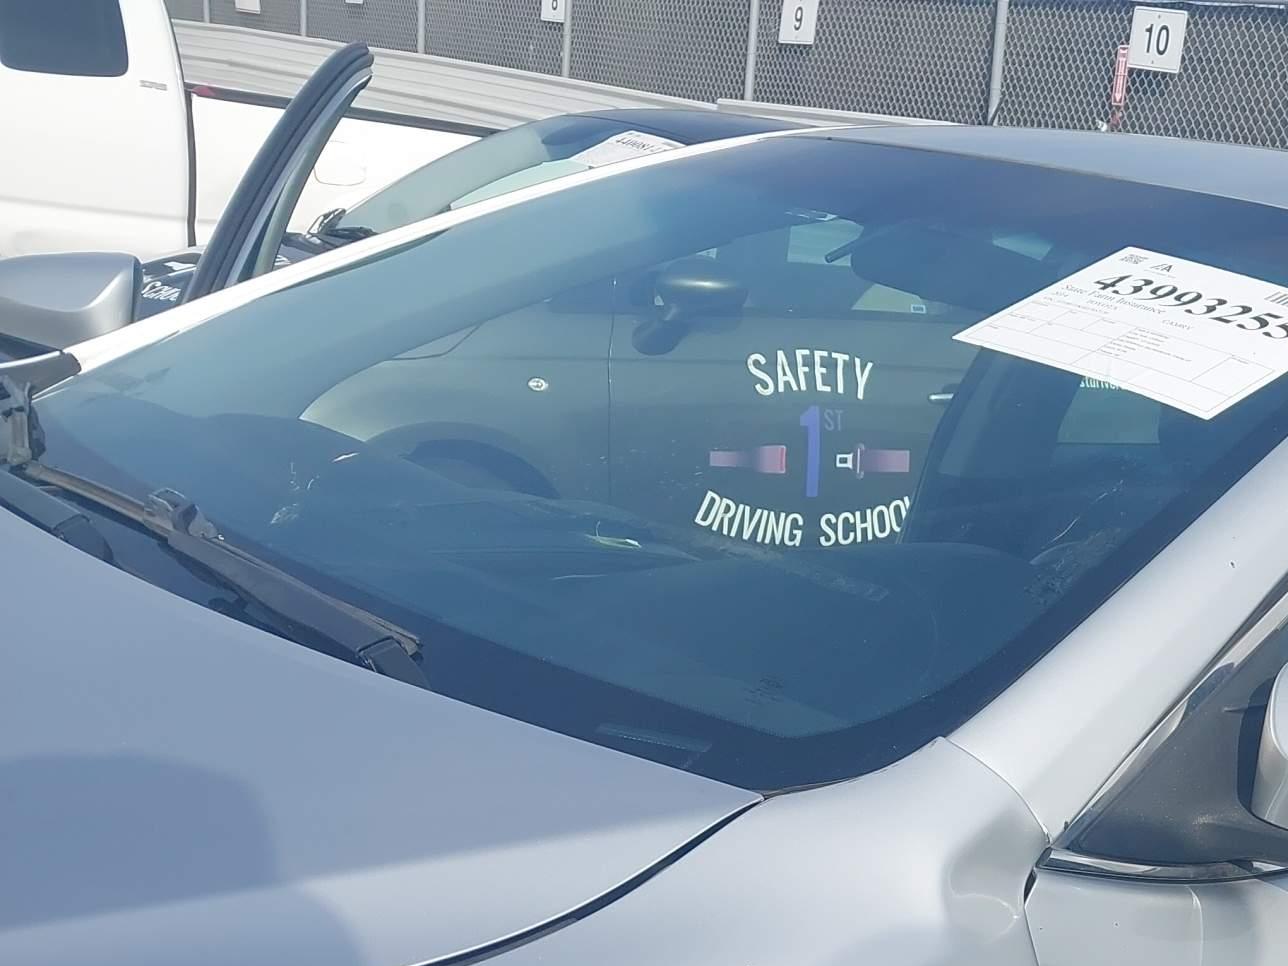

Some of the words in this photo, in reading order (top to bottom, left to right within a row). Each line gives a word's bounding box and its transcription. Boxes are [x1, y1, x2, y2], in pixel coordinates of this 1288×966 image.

[793, 6, 804, 31] 9
[1145, 23, 1170, 56] 10
[1088, 289, 1115, 303] Farm
[1116, 295, 1168, 316] Insurance
[746, 348, 874, 401] SAFETY
[694, 490, 804, 547] DRIVING
